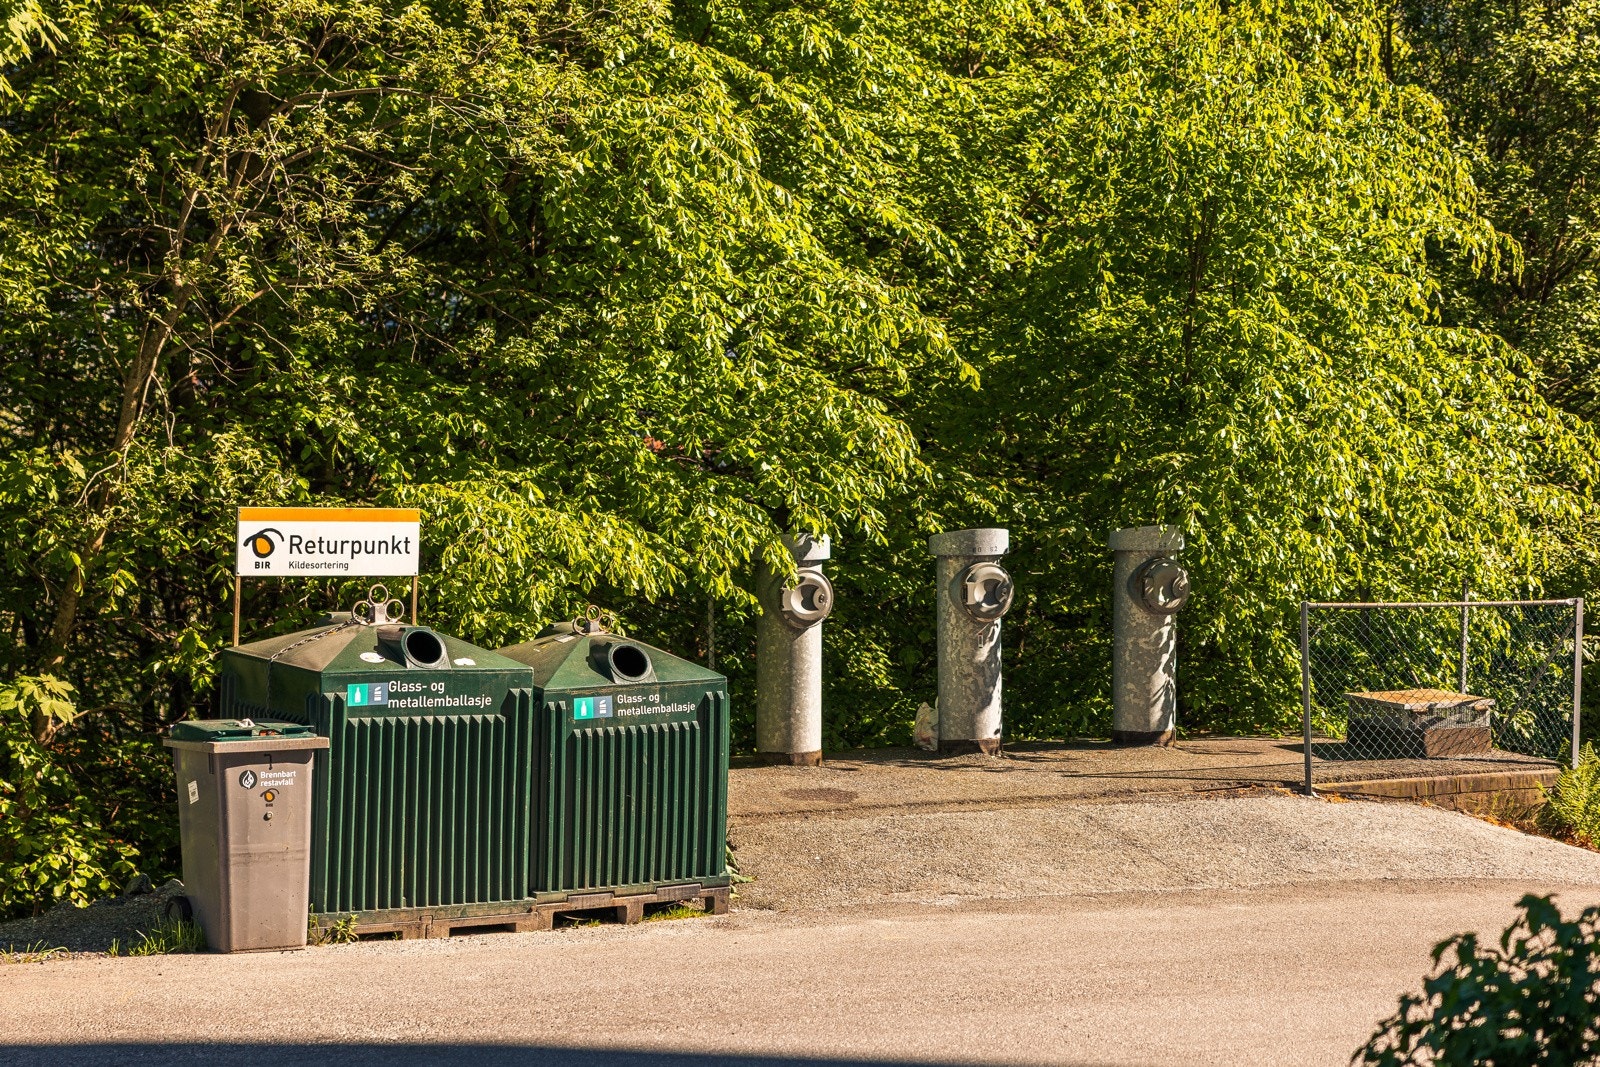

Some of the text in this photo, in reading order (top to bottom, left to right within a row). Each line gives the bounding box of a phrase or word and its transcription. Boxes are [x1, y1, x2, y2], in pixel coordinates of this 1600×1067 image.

[289, 535, 411, 559] Returpunkt
[254, 561, 271, 569] BIR
[288, 561, 349, 571] Kildesortering
[388, 680, 445, 694] Glass- og
[388, 694, 492, 709] metallemballasje
[617, 693, 660, 704] Glass- og
[617, 702, 696, 717] metallemballasje
[260, 778, 294, 787] restavfall
